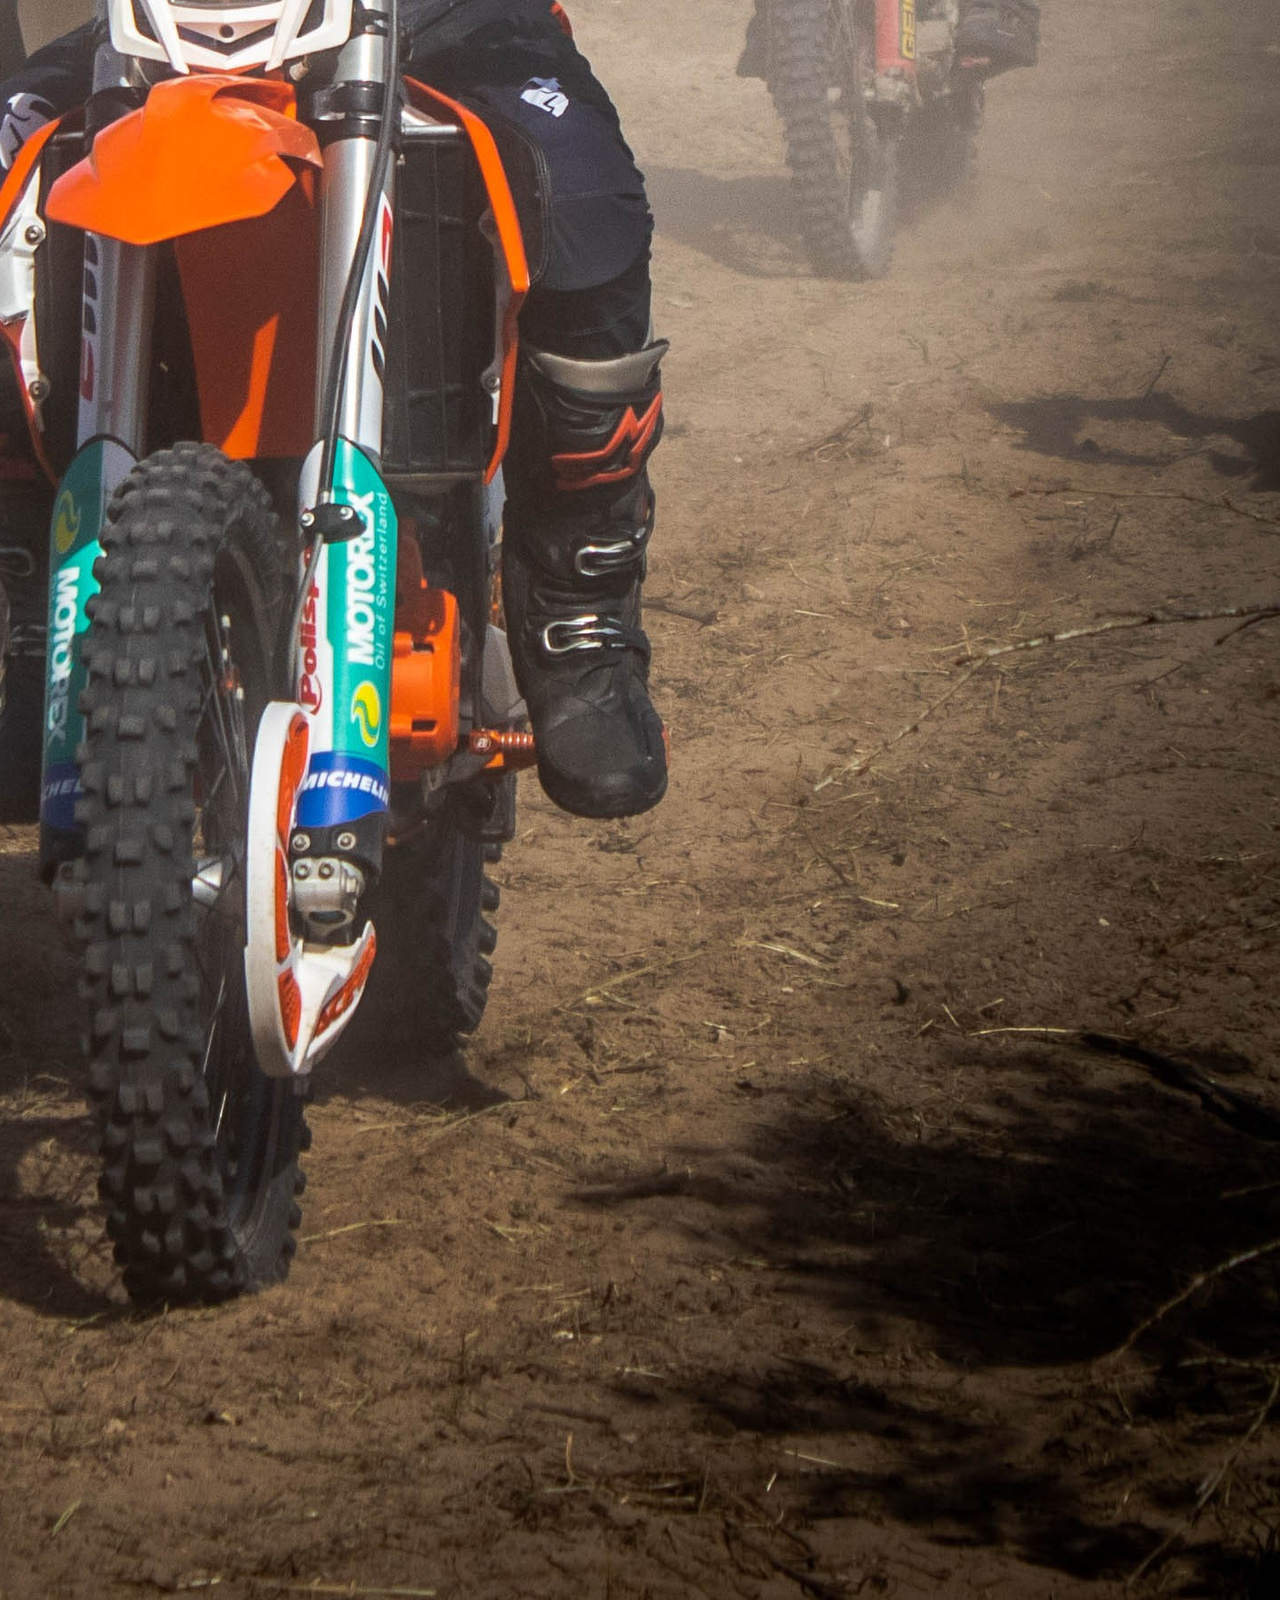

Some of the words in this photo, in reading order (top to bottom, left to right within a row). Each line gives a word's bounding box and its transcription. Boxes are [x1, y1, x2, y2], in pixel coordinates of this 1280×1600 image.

[376, 492, 388, 608] Switzerland
[376, 614, 386, 636] of
[375, 641, 386, 670] Oil
